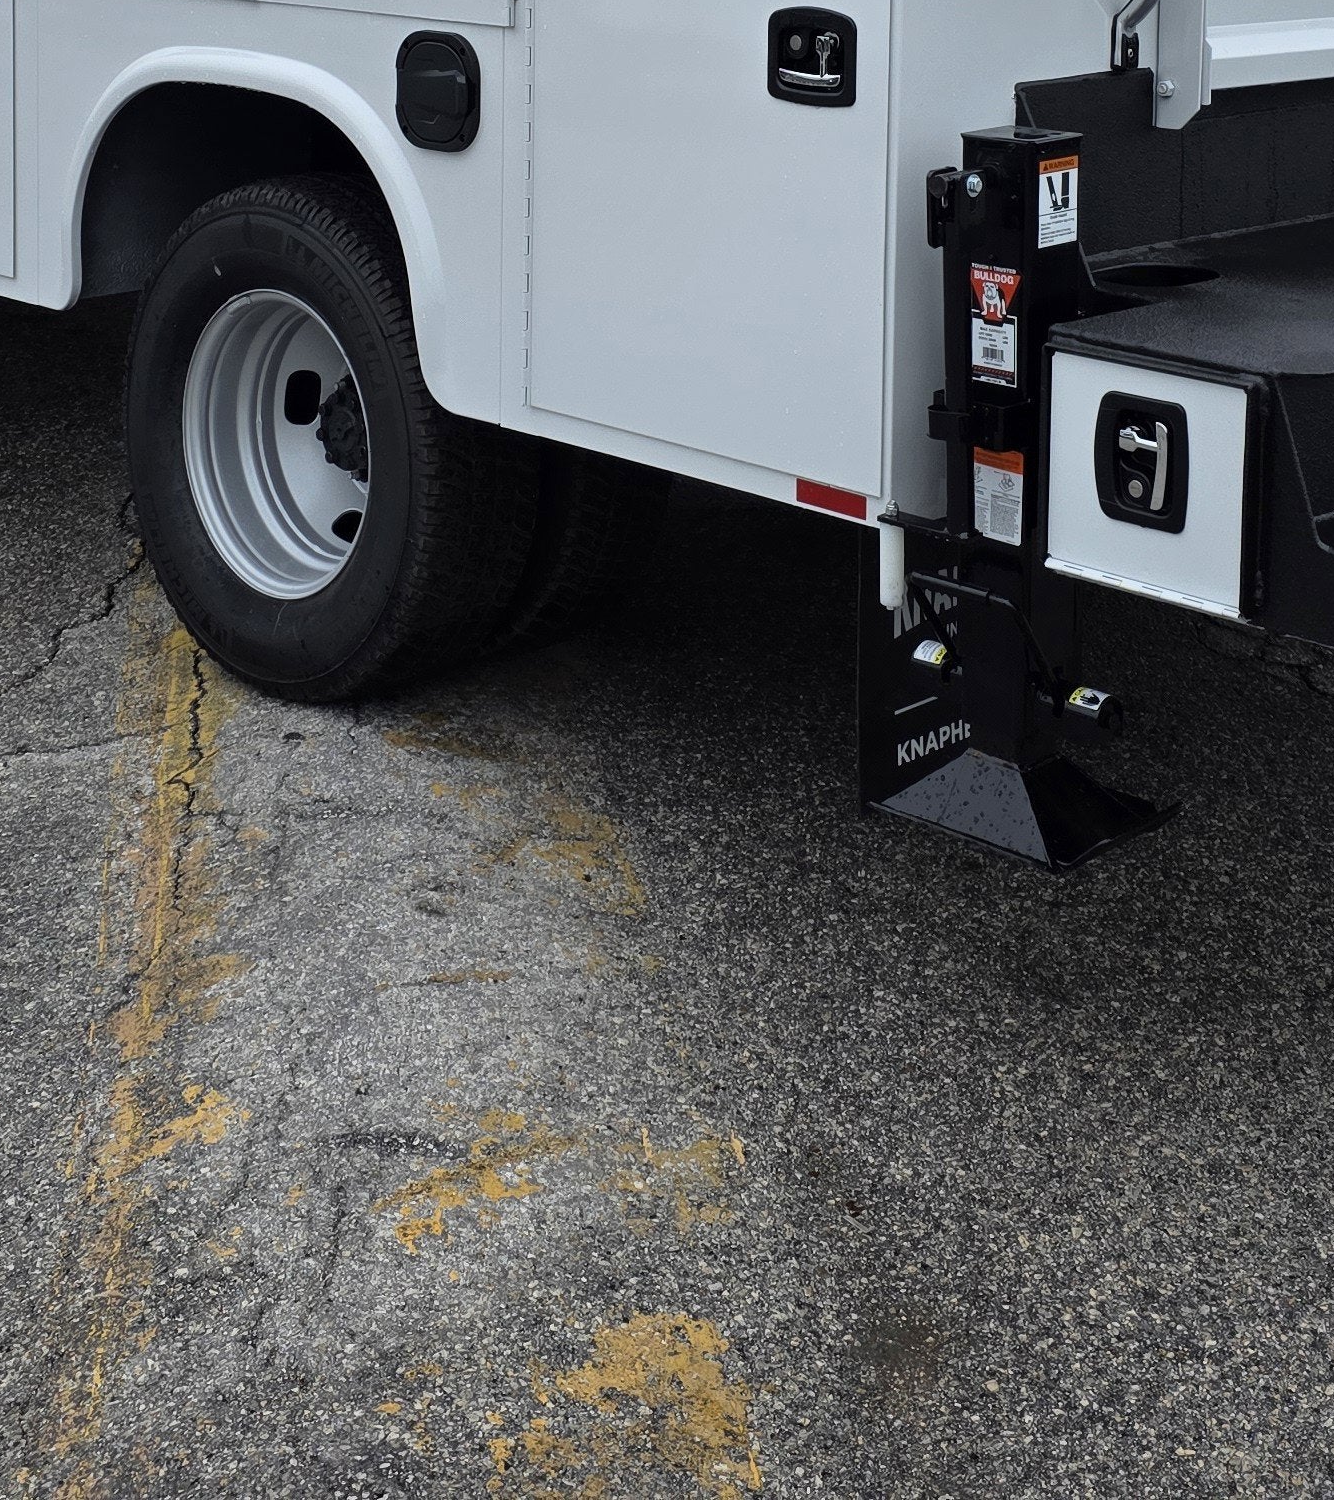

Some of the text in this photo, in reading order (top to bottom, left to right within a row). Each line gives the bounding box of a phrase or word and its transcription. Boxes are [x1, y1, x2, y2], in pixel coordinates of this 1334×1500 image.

[1048, 159, 1075, 170] WARNING
[971, 262, 989, 270] TOUGH
[993, 266, 1017, 275] TRUSTED
[973, 270, 1014, 285] BULLDOG
